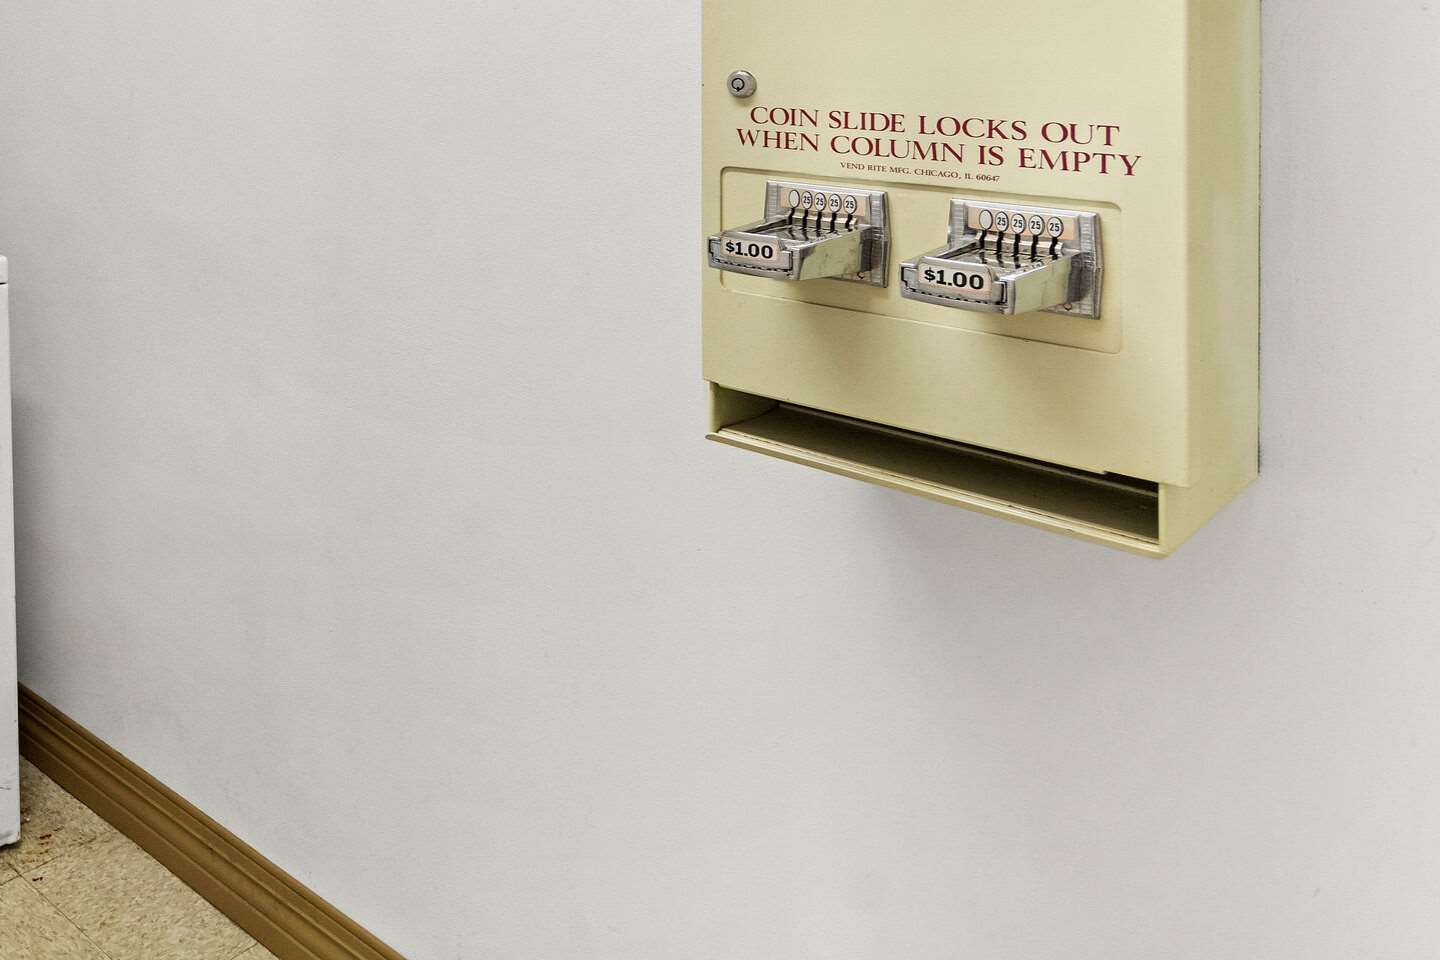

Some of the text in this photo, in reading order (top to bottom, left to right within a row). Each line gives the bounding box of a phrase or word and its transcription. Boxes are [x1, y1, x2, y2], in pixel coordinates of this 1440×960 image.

[749, 105, 1121, 147] COIN SLIDE LOCKS OUT
[736, 127, 1144, 177] WHEN COLUMN IS EMPTY
[839, 161, 865, 171] VEND
[867, 164, 887, 173] RITE
[889, 167, 912, 175] MFG.
[914, 168, 962, 181] CHICAGO,
[976, 174, 1001, 183] 60647
[803, 195, 855, 210] 25 25 25 25
[997, 217, 1060, 232] 25 25 25 25
[725, 240, 774, 260] $1.00
[924, 267, 984, 290] $1.00
